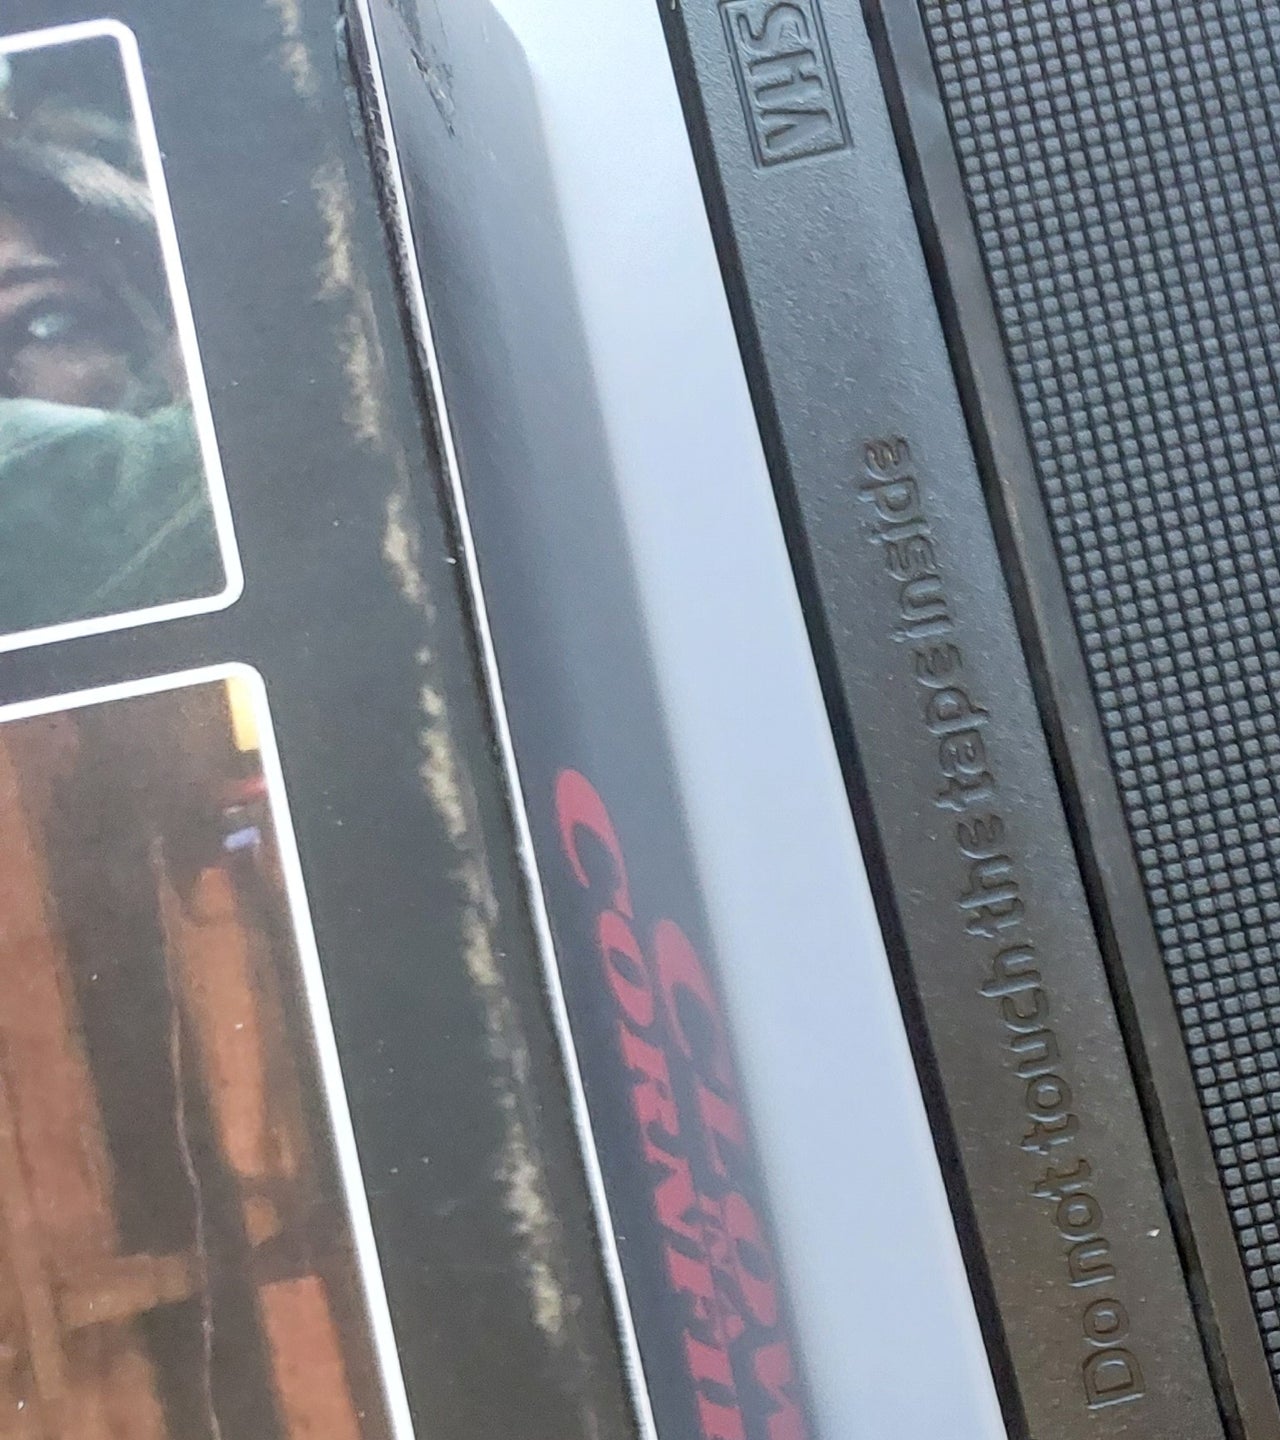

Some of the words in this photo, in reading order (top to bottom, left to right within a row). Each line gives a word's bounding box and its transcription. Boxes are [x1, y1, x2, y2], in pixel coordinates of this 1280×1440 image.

[735, 1, 833, 151] VHS
[859, 434, 955, 644] inside
[912, 641, 995, 812] tape
[956, 813, 1025, 938] the
[978, 945, 1079, 1155] touch
[1031, 1159, 1117, 1288] not
[1081, 1298, 1144, 1410] Do
